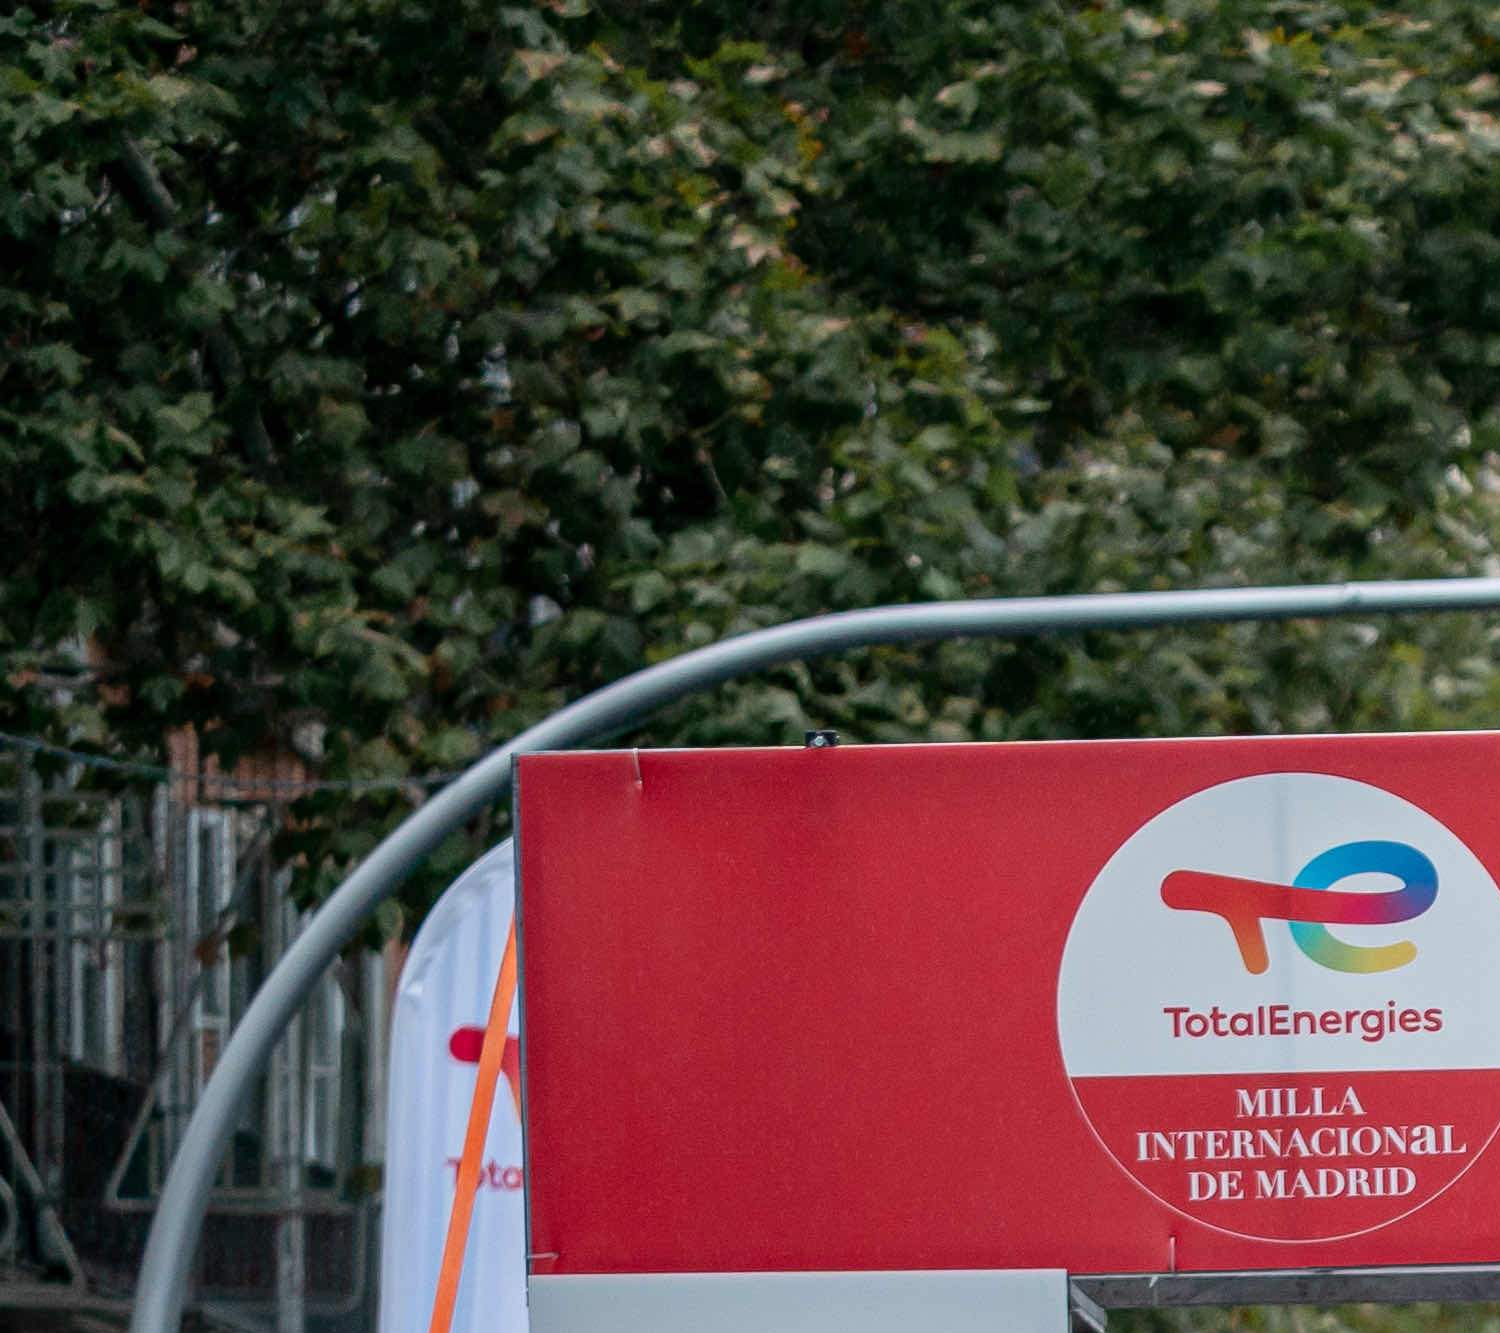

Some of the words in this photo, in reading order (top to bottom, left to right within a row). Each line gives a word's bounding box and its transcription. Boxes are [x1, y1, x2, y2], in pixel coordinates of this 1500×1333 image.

[1164, 1001, 1443, 1042] TotalEnergies
[1237, 1087, 1366, 1118] MILLA
[1188, 1171, 1244, 1201] DE
[1255, 1166, 1417, 1200] MADRID
